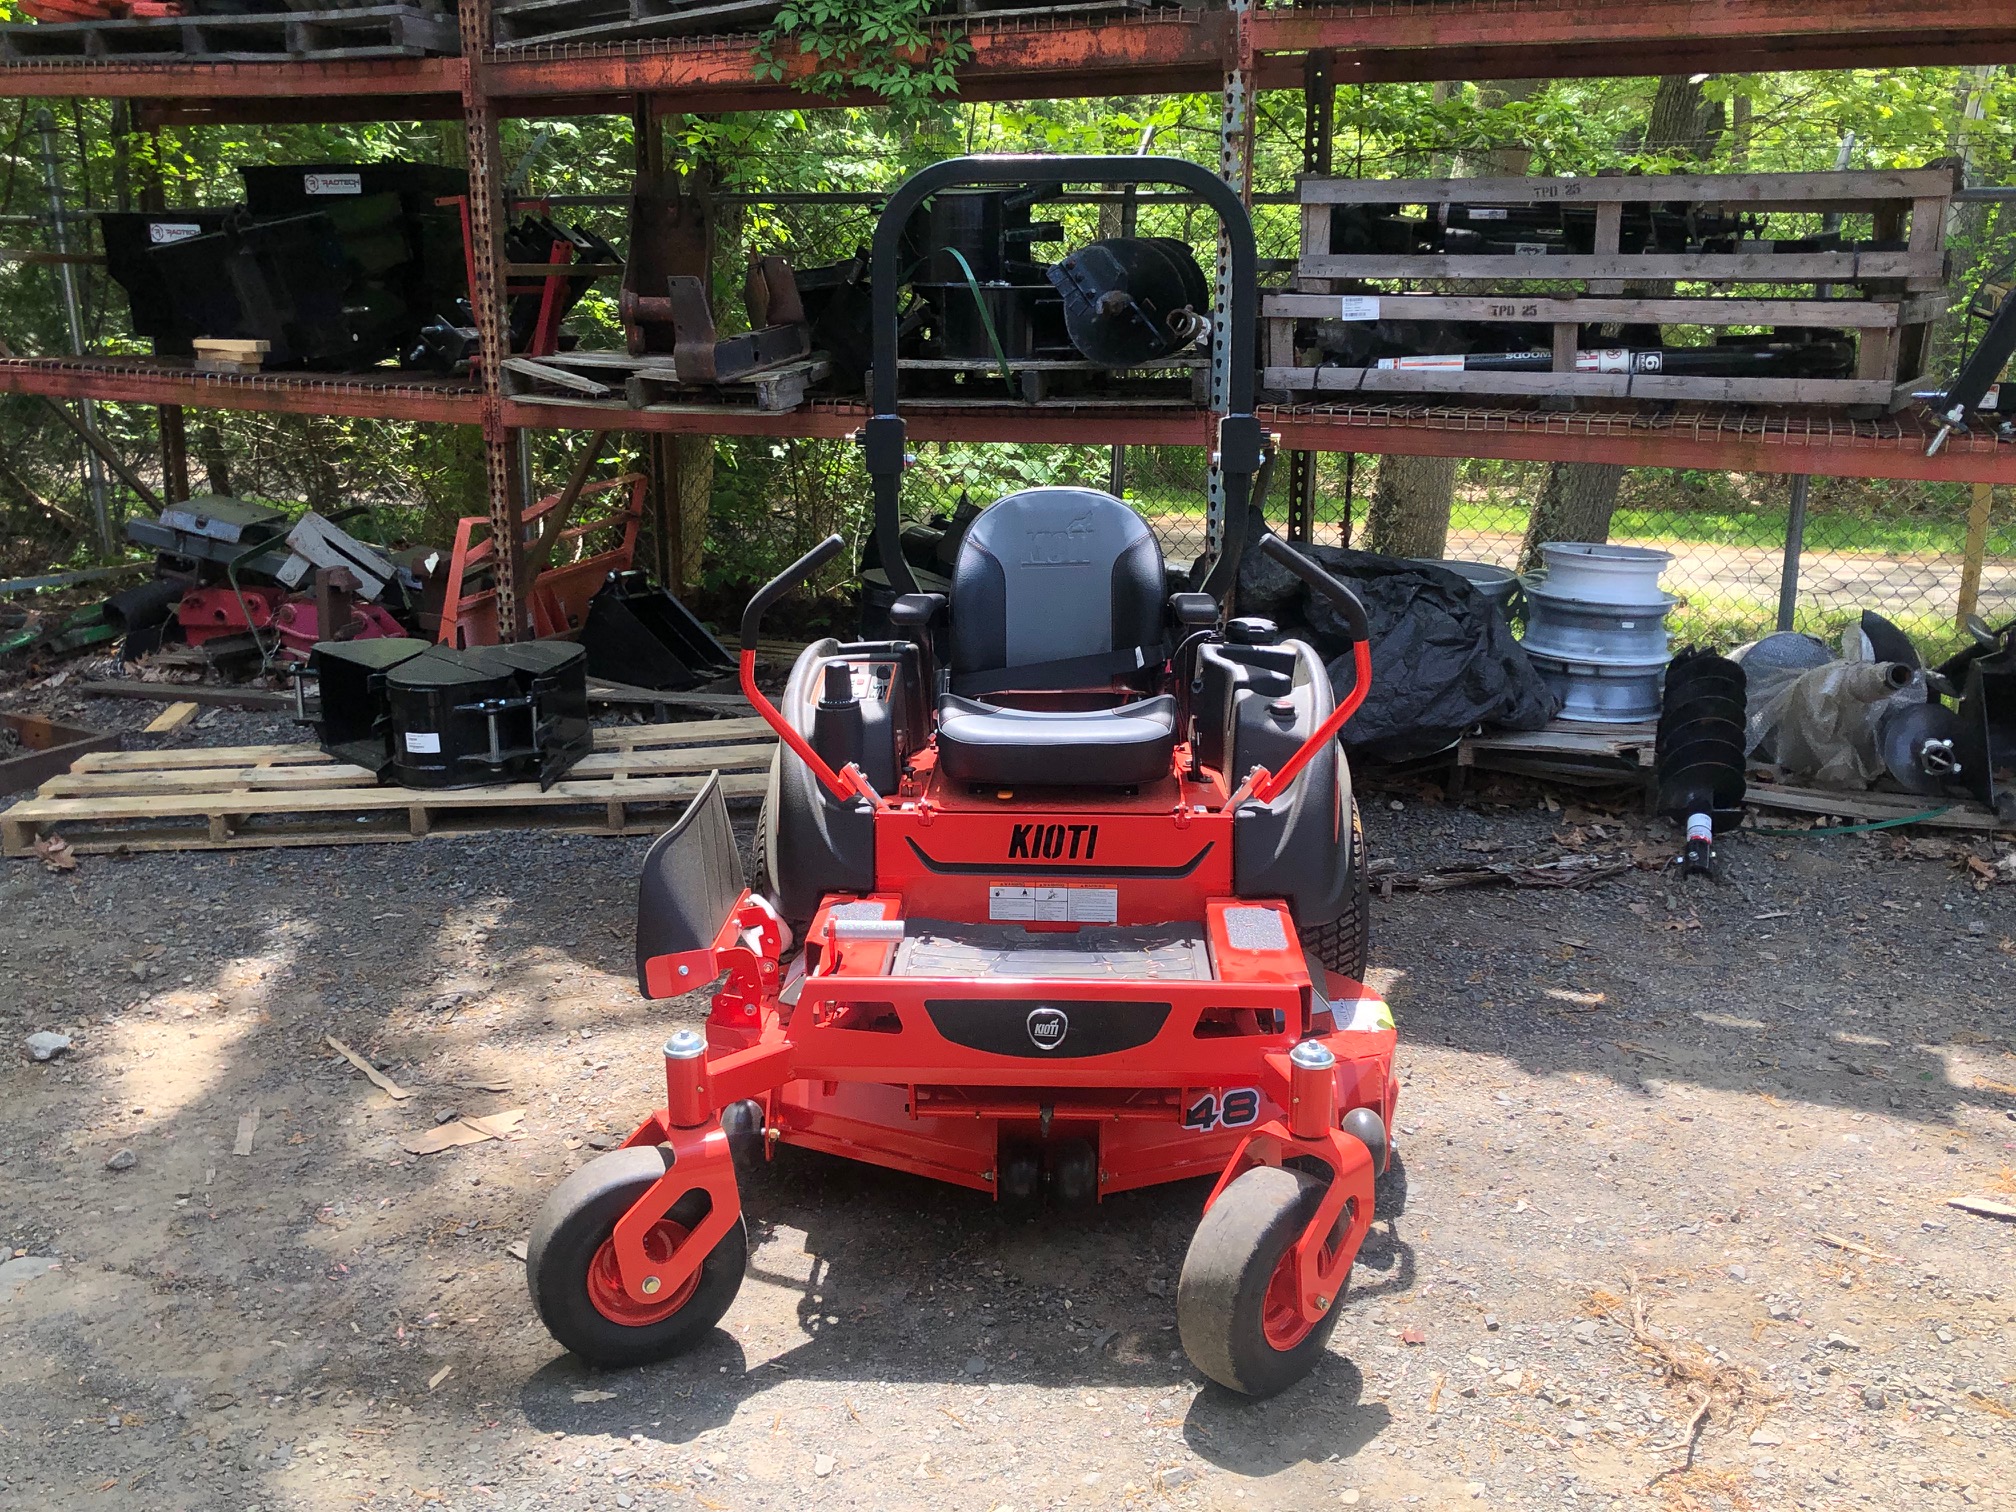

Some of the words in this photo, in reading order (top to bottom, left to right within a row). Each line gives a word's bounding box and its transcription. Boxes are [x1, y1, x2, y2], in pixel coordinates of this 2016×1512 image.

[1564, 182, 1581, 195] 25
[1491, 304, 1515, 317] TPD
[1521, 304, 1538, 317] 25
[1505, 351, 1552, 360] WOODS
[1008, 823, 1099, 860] KIOTI
[1034, 1023, 1059, 1035] KIOTI
[1182, 1087, 1260, 1132] 48
